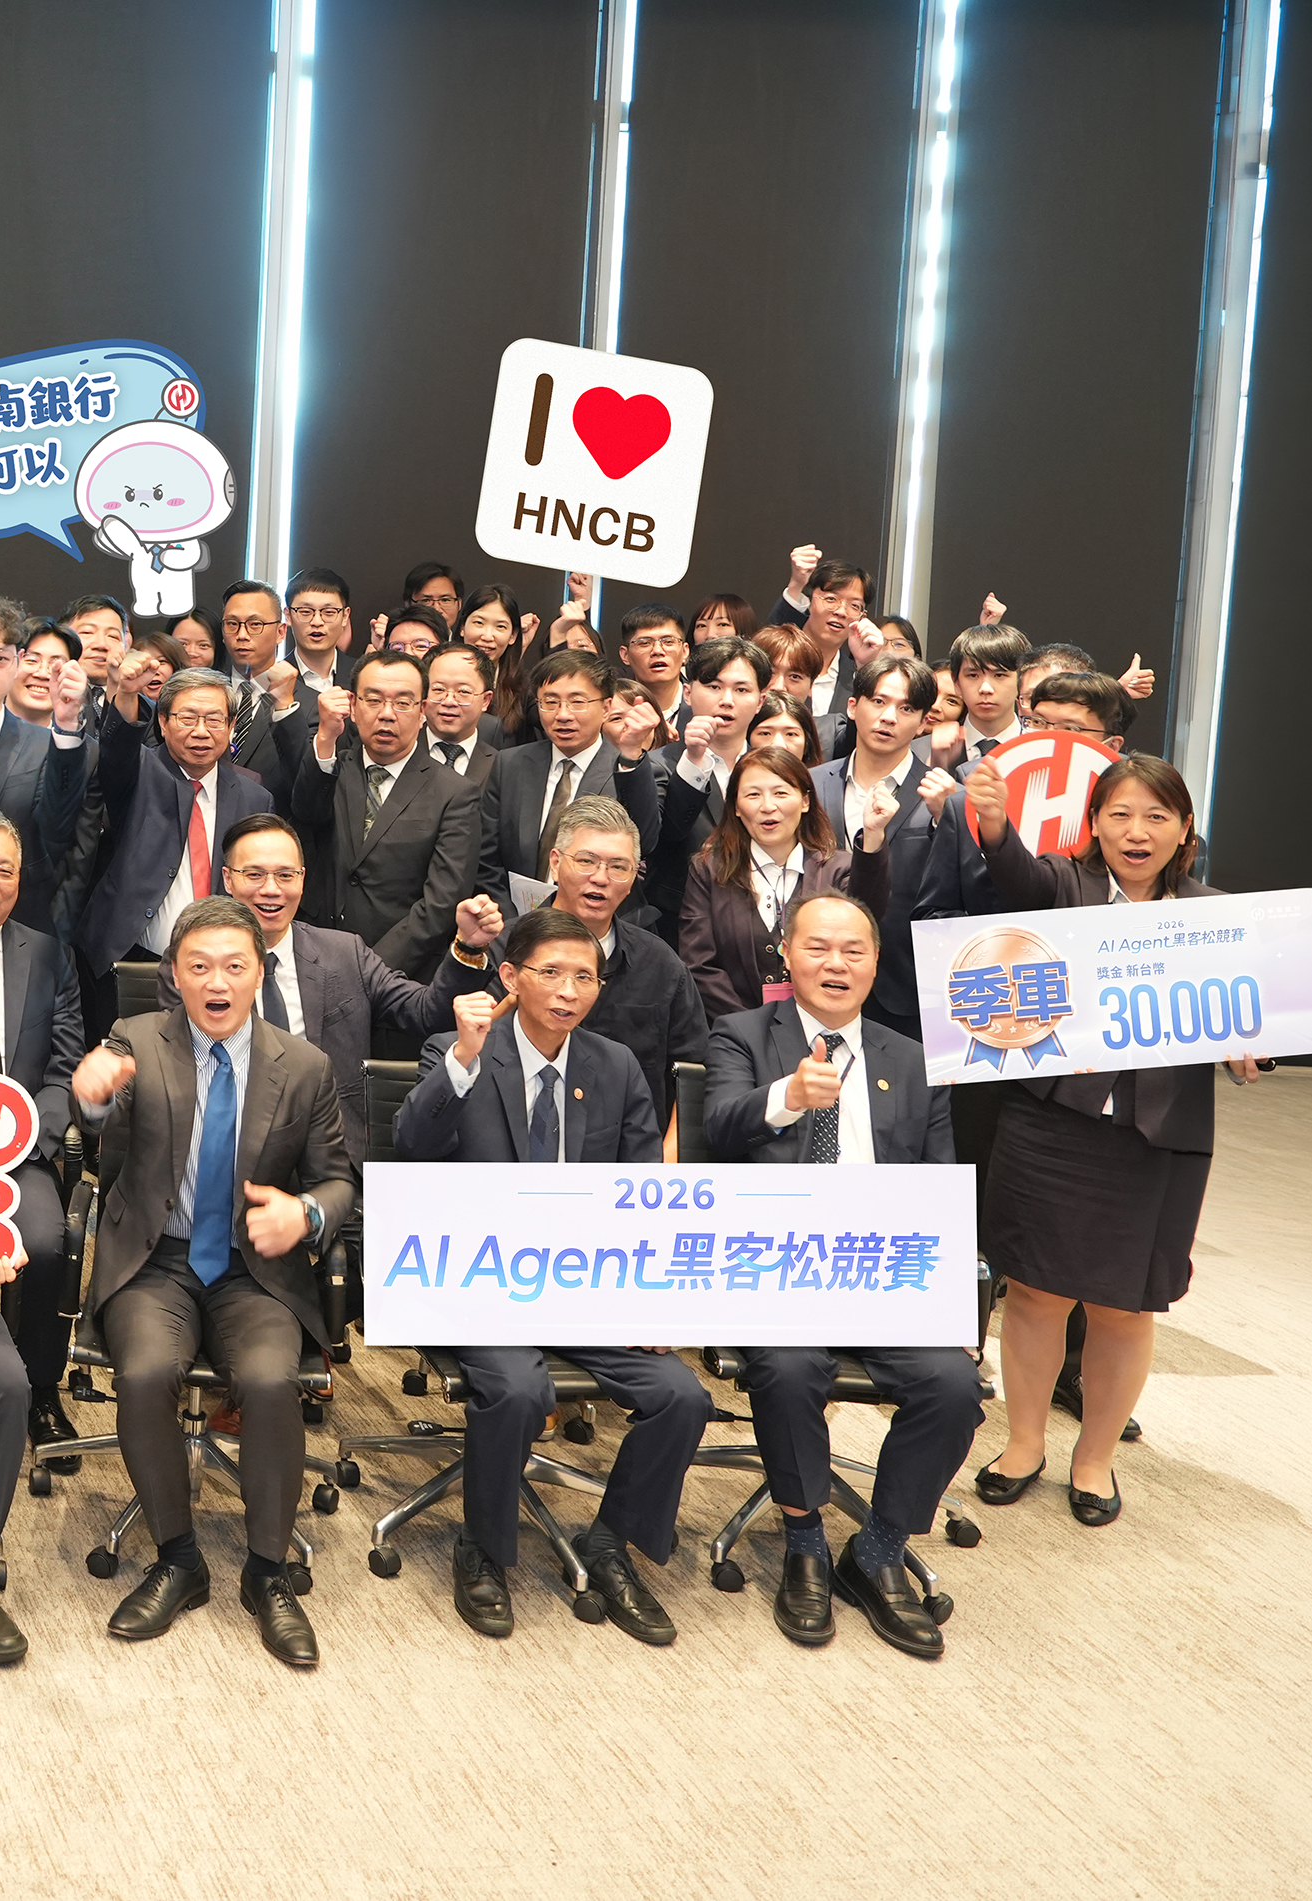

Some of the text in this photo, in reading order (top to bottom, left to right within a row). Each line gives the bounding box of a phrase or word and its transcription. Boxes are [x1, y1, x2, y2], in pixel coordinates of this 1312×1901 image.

[525, 373, 553, 466] I
[513, 492, 656, 553] HNCB
[1097, 938, 1115, 954] AI
[1157, 919, 1185, 931] 2026
[948, 960, 1073, 1028] 季軍
[1096, 961, 1166, 981] 獎金 新台幣
[1099, 975, 1263, 1050] 30,000
[613, 1177, 715, 1210] 2026
[384, 1234, 451, 1288] AI
